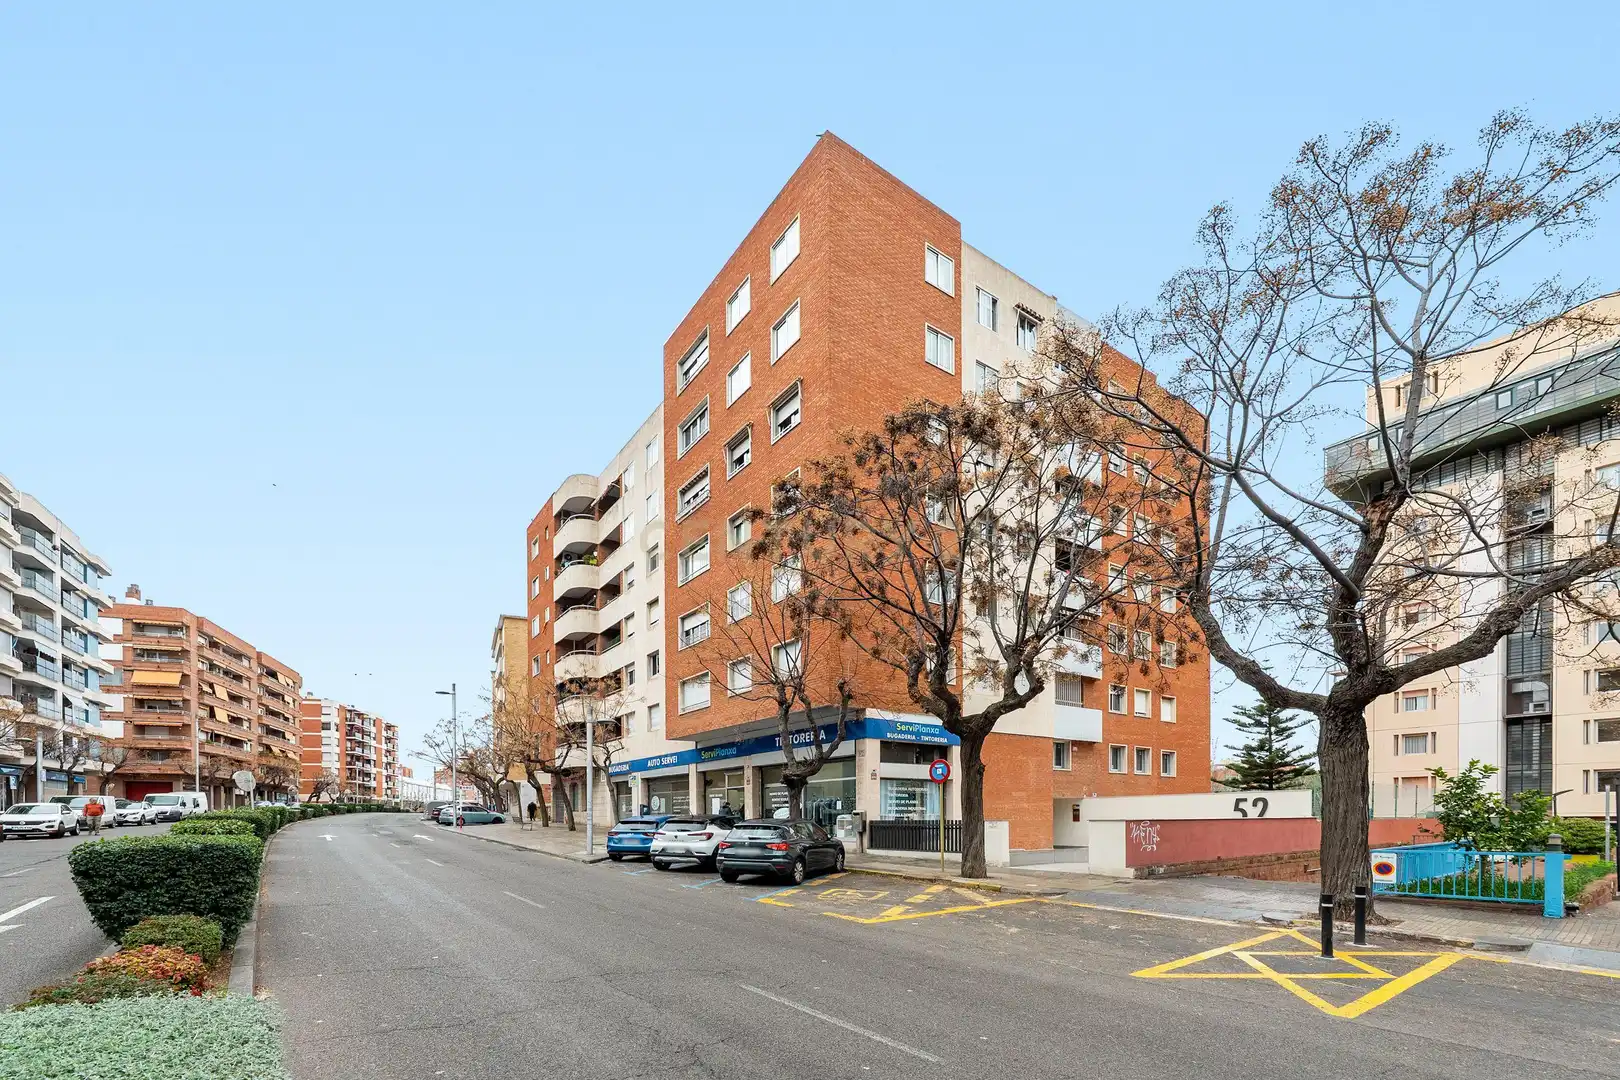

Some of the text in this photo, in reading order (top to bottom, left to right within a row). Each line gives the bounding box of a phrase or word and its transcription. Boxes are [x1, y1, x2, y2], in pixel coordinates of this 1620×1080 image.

[896, 722, 940, 734] ServiPlanxa
[775, 729, 826, 746] TITORERA
[886, 732, 916, 740] BUGADERIA
[920, 735, 948, 743] TINTORERIA
[701, 747, 737, 759] ServiPlanxa
[647, 755, 678, 767] AUTO SERVEI
[1233, 797, 1269, 818] 52
